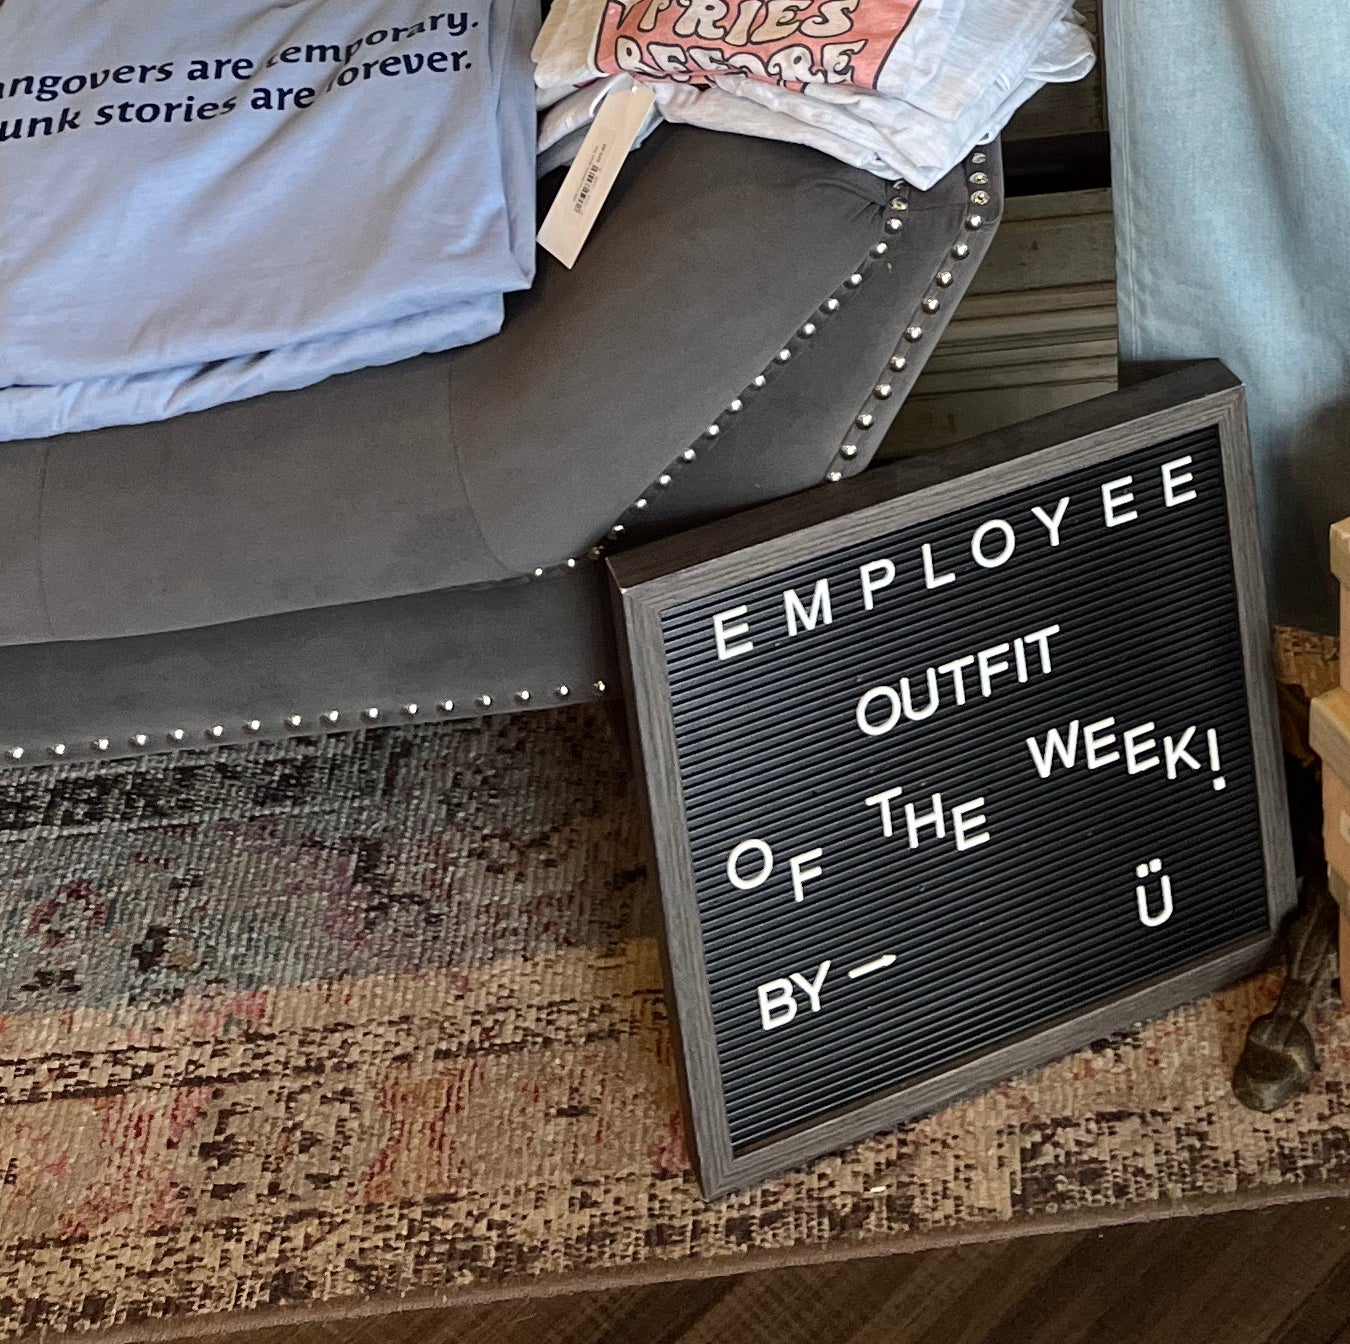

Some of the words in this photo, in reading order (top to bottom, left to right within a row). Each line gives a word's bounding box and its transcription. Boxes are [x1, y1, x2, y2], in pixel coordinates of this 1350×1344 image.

[0, 108, 81, 142] unk
[94, 96, 237, 127] stories
[250, 86, 316, 111] are
[326, 49, 472, 93] orever.
[187, 57, 254, 81] are
[712, 455, 1197, 660] EMPLOYEE
[856, 624, 1061, 737] OUTFIT
[727, 838, 824, 903] OF
[865, 786, 990, 852] THE
[1026, 716, 1227, 791] WEEK!
